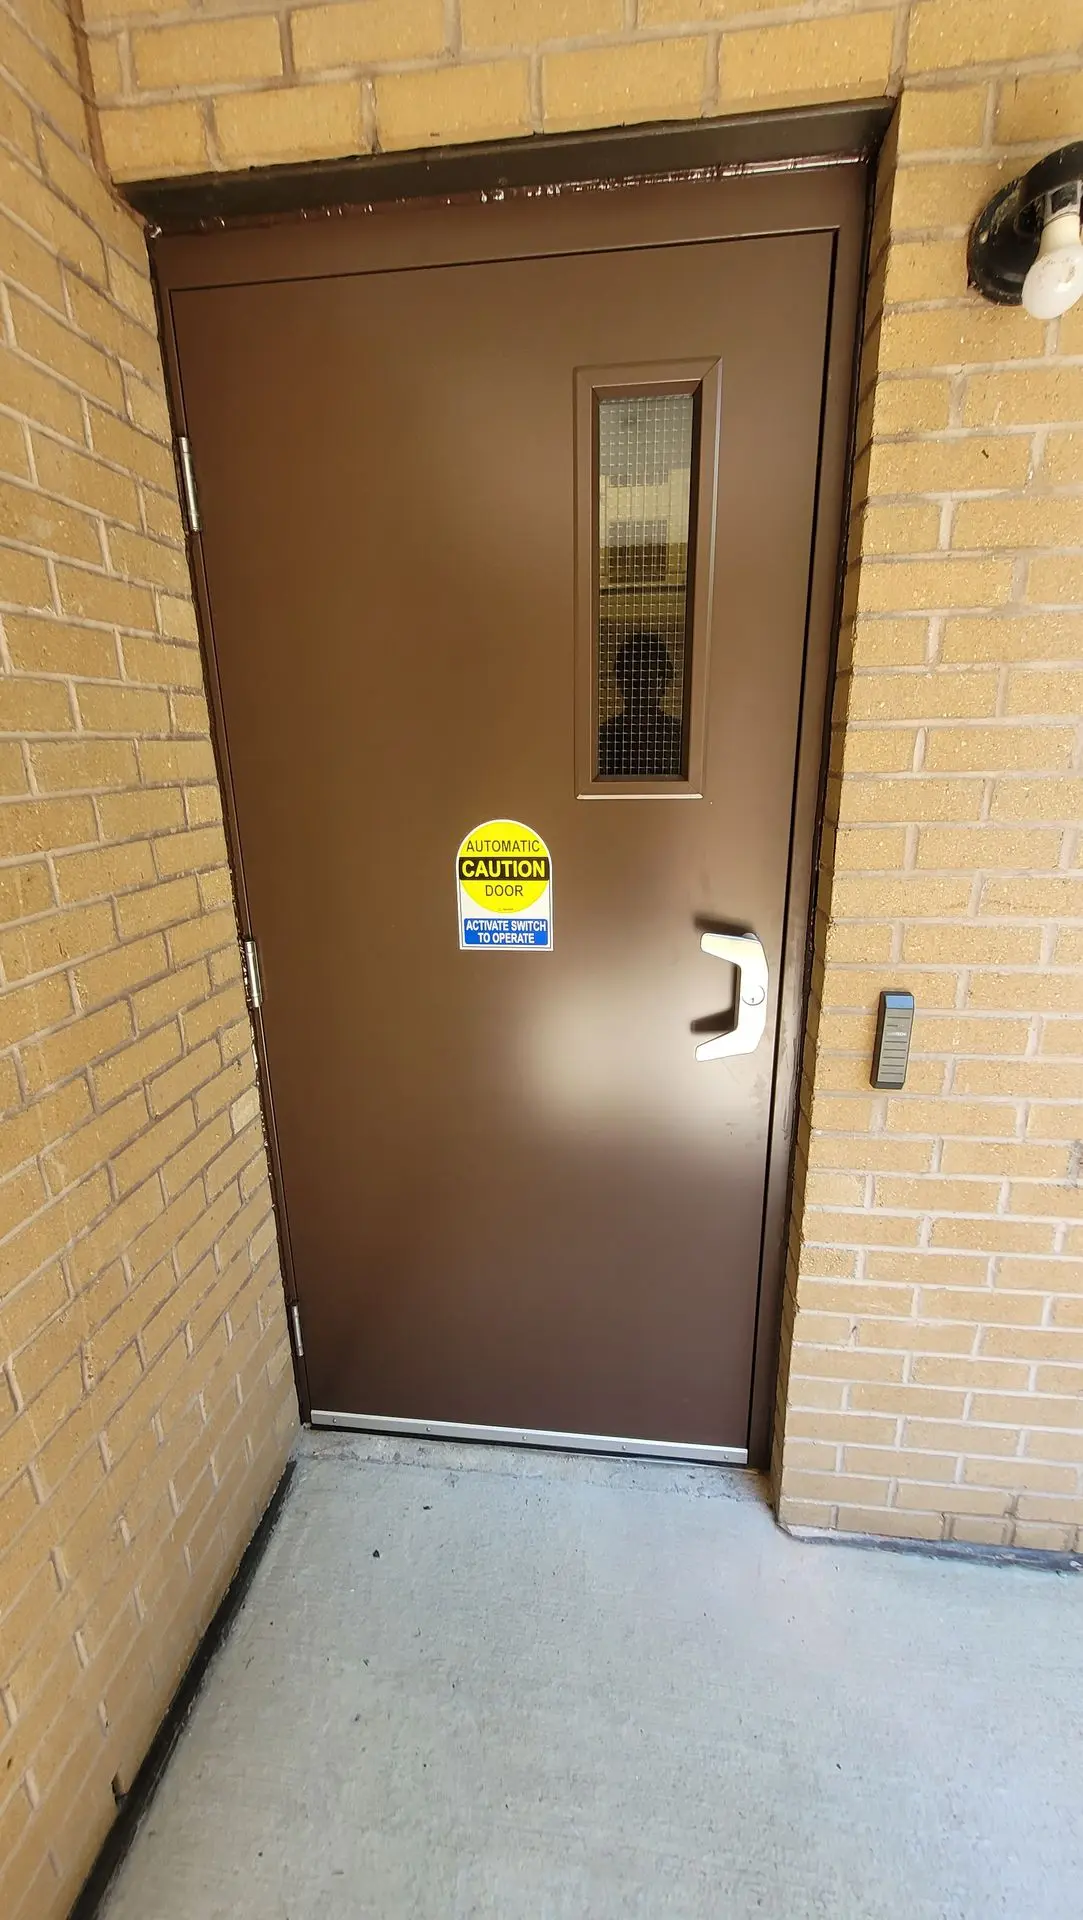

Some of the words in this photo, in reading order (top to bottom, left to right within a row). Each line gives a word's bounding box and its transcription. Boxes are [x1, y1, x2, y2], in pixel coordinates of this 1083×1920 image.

[466, 840, 540, 853] AUTOMATIC
[461, 860, 545, 878] CAUTION
[485, 885, 524, 897] DOOR
[466, 920, 509, 931] ACTIVATE
[511, 920, 546, 932] SWITCH
[478, 932, 491, 943] TO
[492, 933, 535, 944] OPERATE
